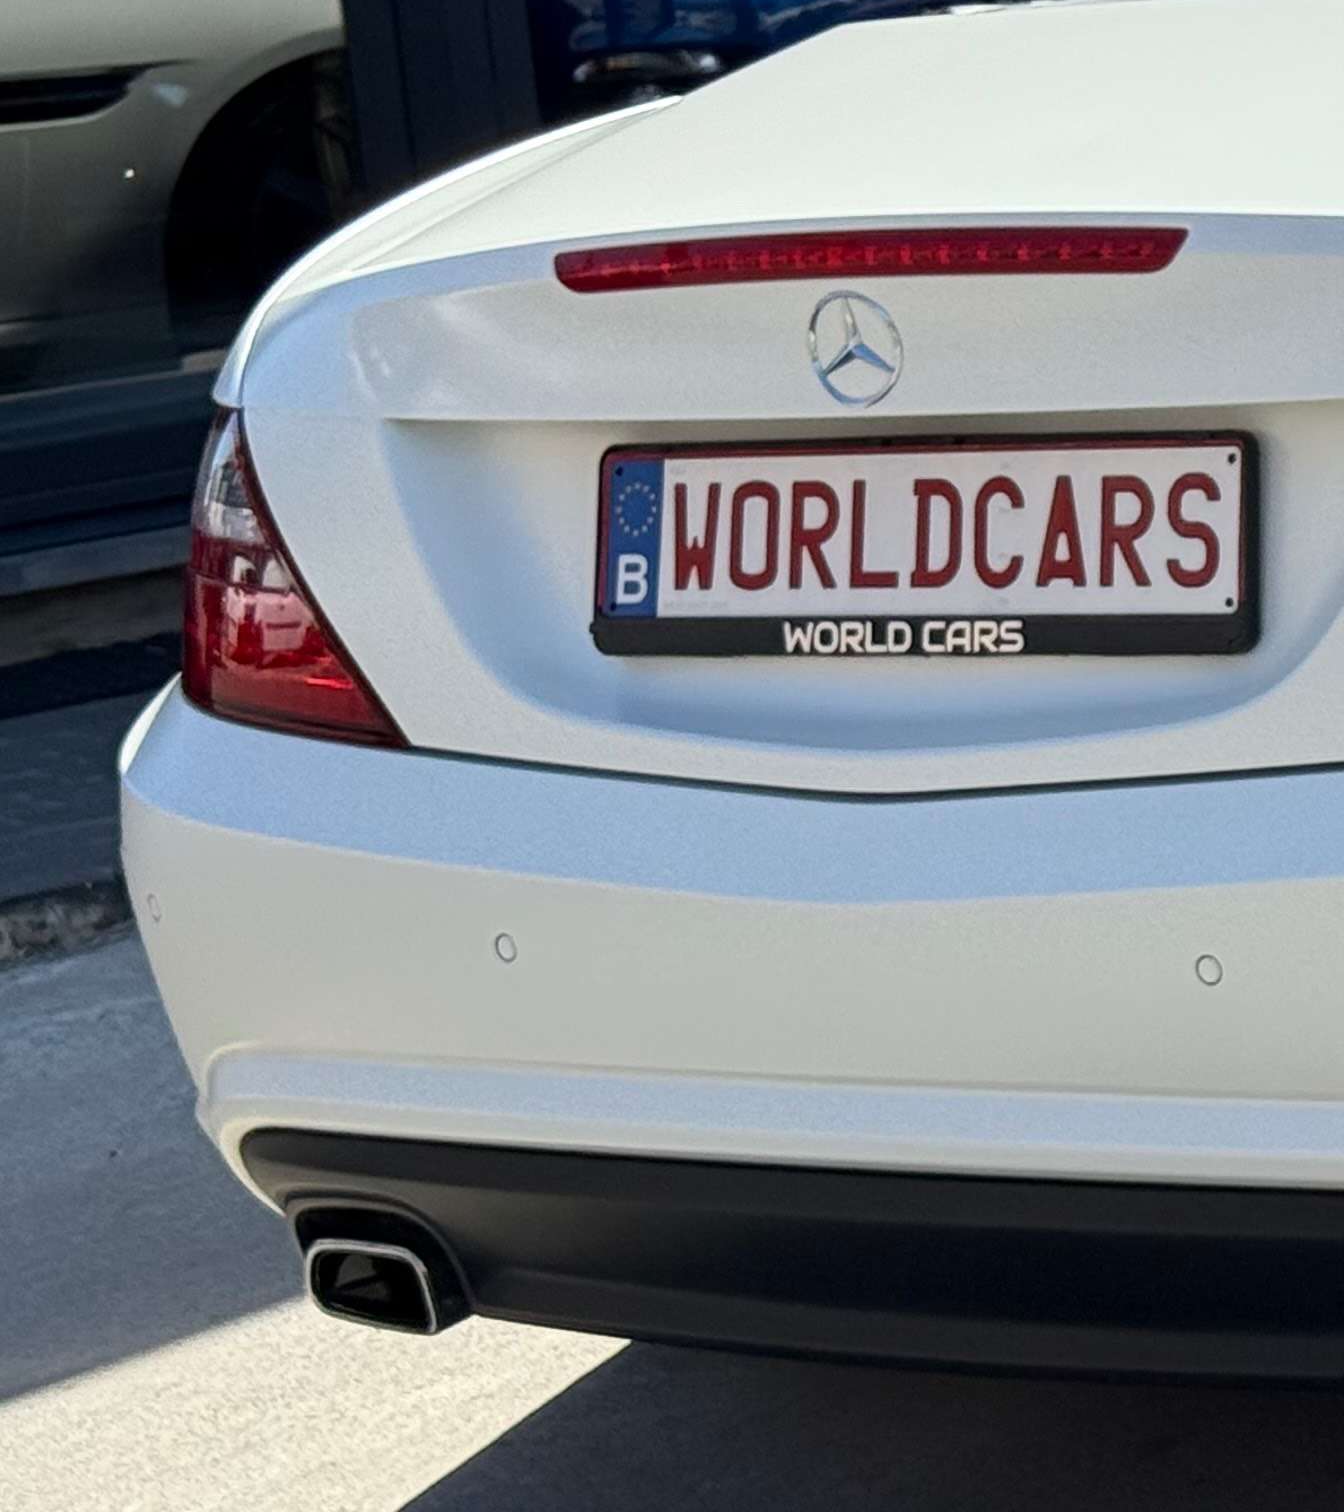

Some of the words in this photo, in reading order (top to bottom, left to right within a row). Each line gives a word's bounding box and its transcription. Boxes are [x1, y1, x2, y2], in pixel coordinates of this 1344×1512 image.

[673, 471, 1222, 591] WORLDCARS
[616, 553, 649, 605] B
[783, 621, 913, 654] WORLD
[920, 619, 1026, 654] CARS
